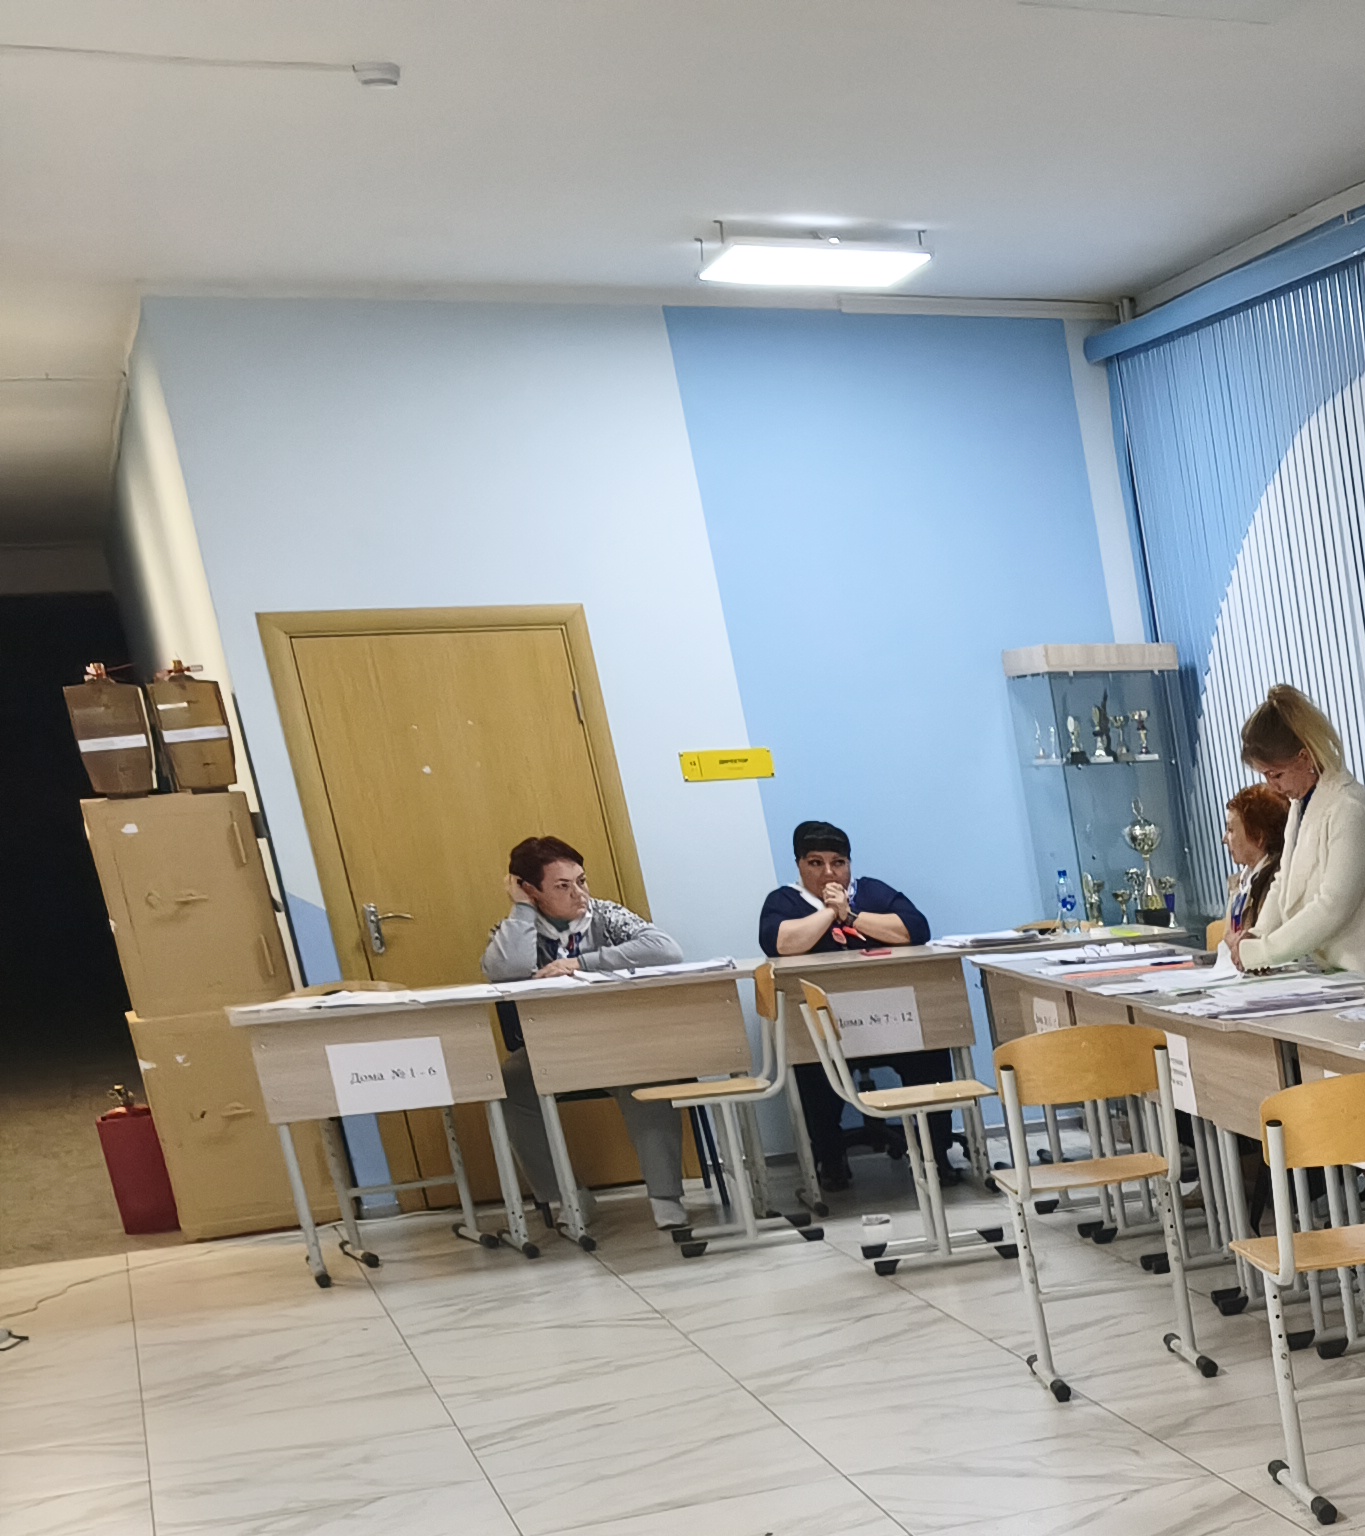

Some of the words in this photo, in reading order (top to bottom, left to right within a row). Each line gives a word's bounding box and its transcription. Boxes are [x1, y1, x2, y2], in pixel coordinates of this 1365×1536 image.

[869, 1014, 881, 1025] №
[901, 1011, 914, 1022] 12
[349, 1071, 385, 1085] Дома
[391, 1068, 406, 1080] №
[410, 1067, 416, 1079] 1
